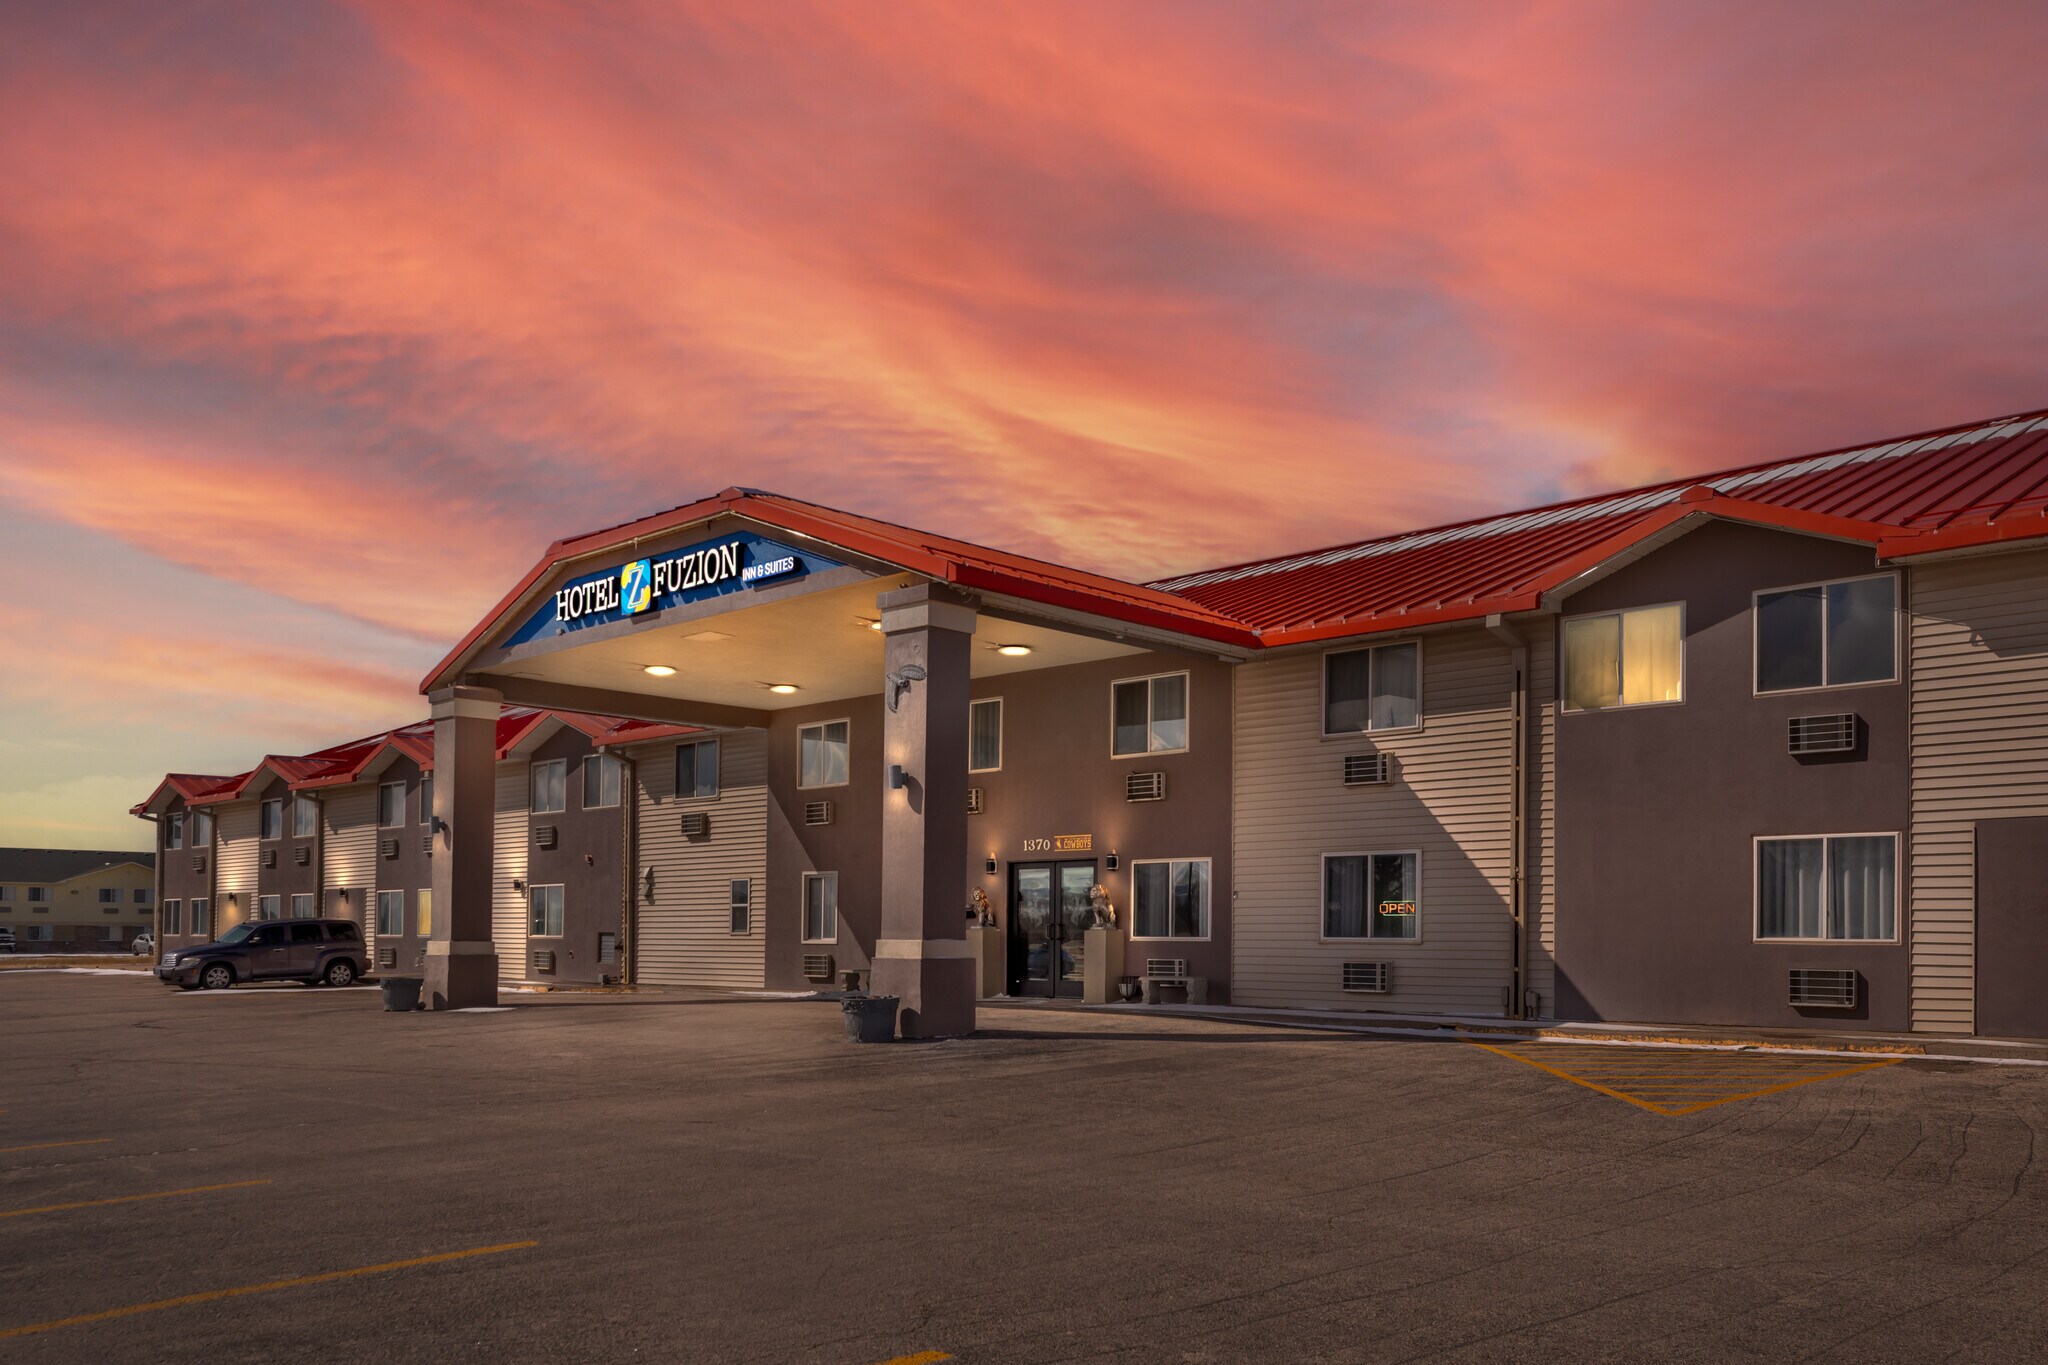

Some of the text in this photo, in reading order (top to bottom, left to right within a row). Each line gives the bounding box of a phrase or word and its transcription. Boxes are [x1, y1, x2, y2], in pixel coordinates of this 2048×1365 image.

[742, 556, 794, 581] INN & SUITES
[556, 576, 619, 621] HOTEL
[652, 541, 740, 598] FUZION
[1023, 838, 1051, 851] 1370
[1063, 839, 1092, 849] COWBOYS
[1379, 903, 1415, 914] OPEN
